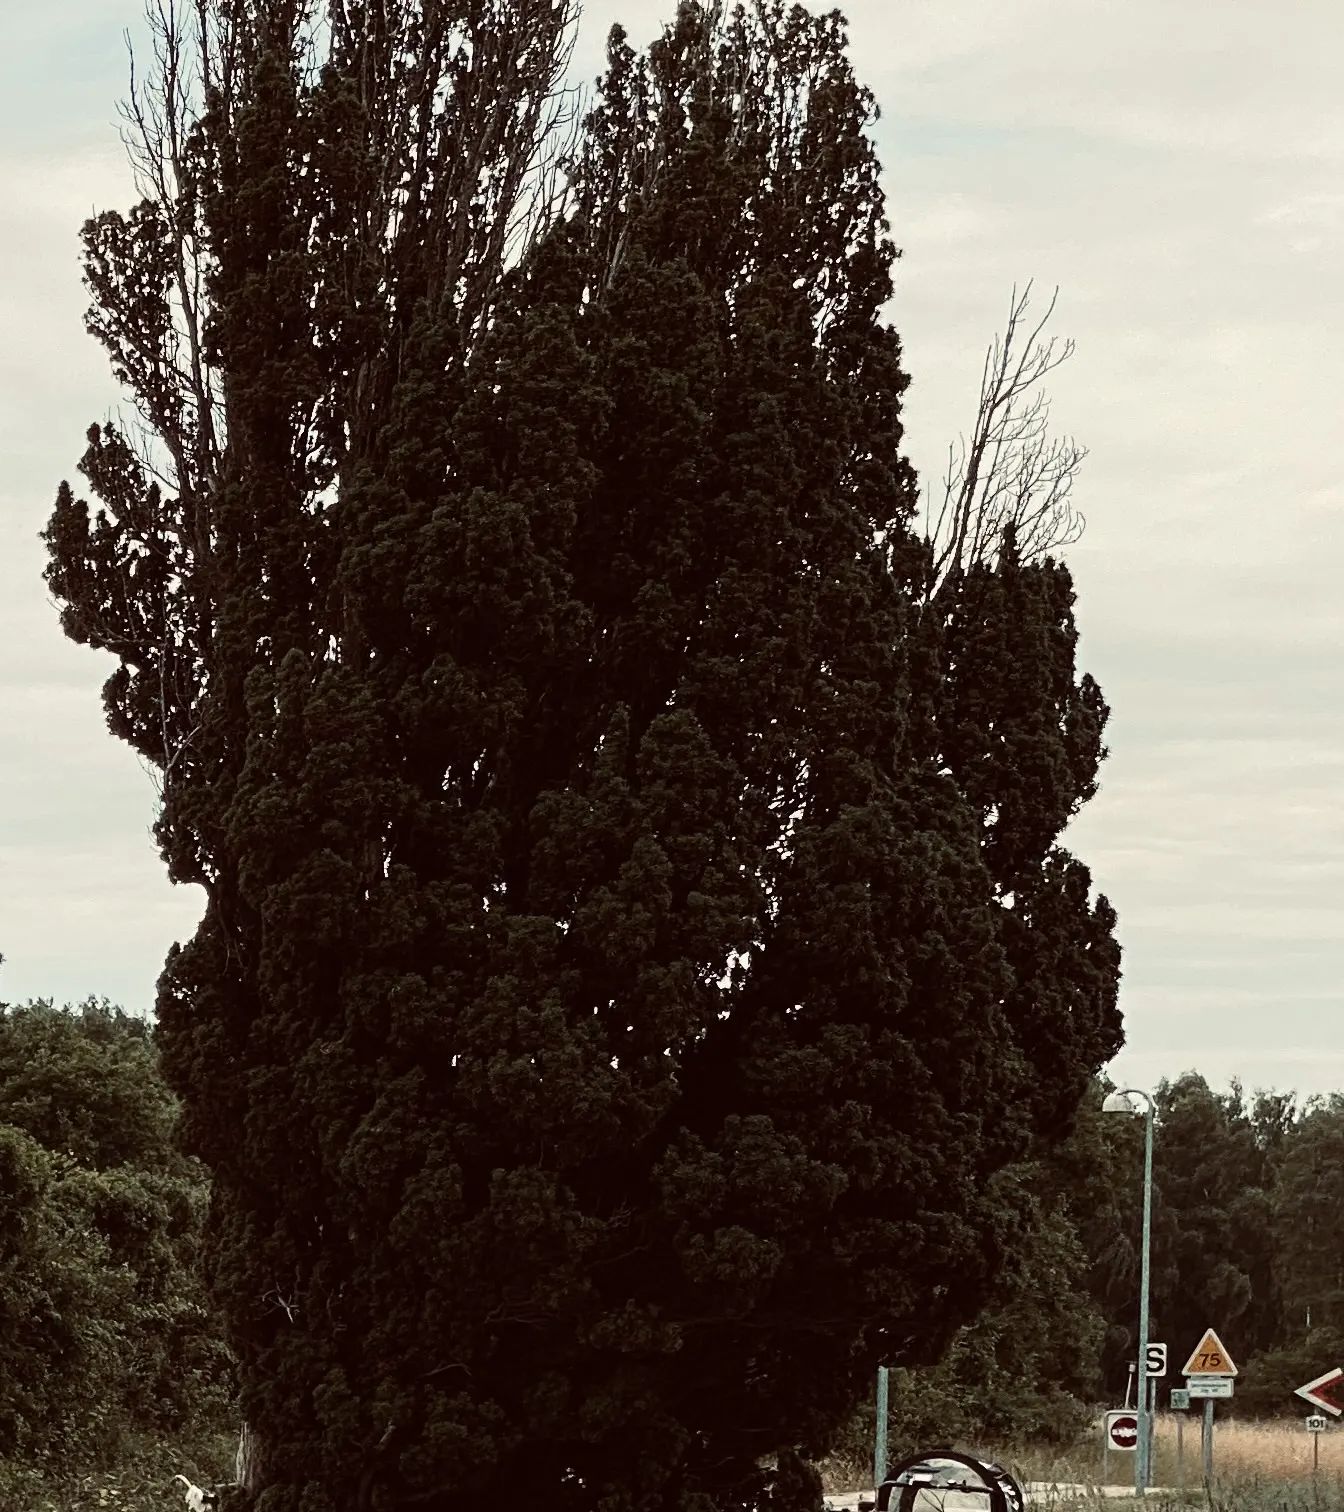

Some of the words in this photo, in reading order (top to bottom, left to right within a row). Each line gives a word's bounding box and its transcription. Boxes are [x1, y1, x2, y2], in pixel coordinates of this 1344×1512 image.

[1146, 1347, 1165, 1372] S
[1199, 1352, 1221, 1368] 75
[1308, 1419, 1324, 1429] 101
